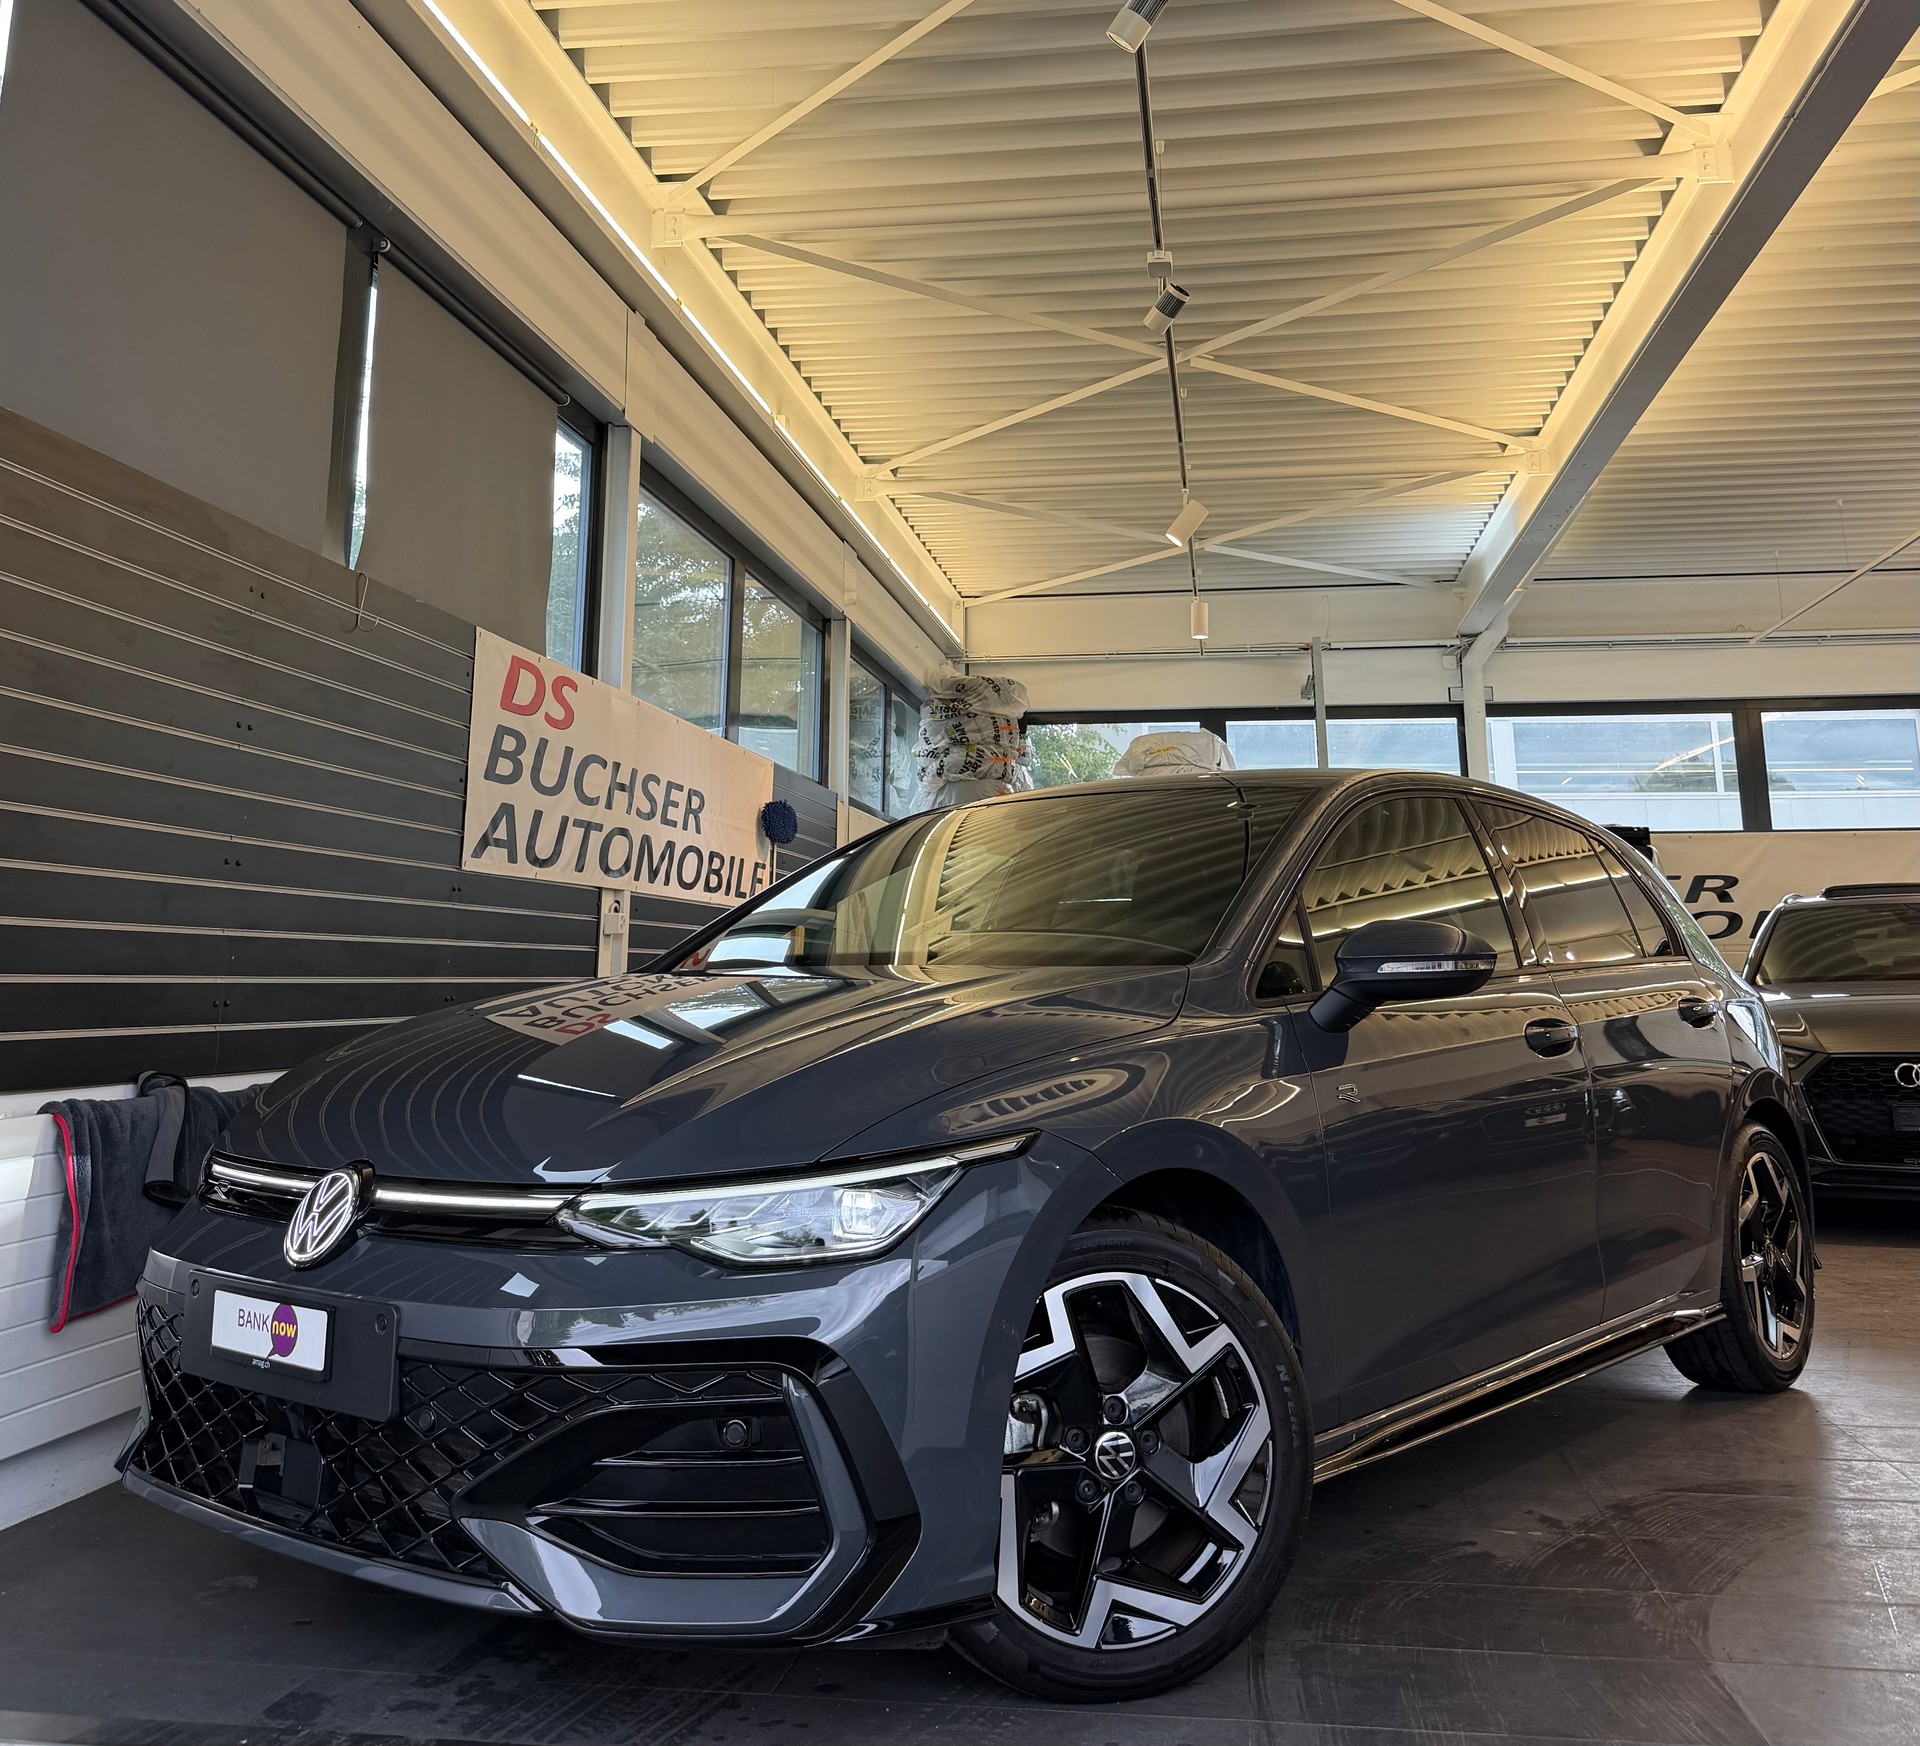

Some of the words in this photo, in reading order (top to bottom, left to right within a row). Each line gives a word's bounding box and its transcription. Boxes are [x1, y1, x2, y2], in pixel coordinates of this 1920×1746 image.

[500, 655, 578, 730] DS
[483, 724, 705, 834] BUCHSER
[1665, 875, 1739, 903] R
[238, 1308, 270, 1333] BANK
[272, 1320, 297, 1338] now
